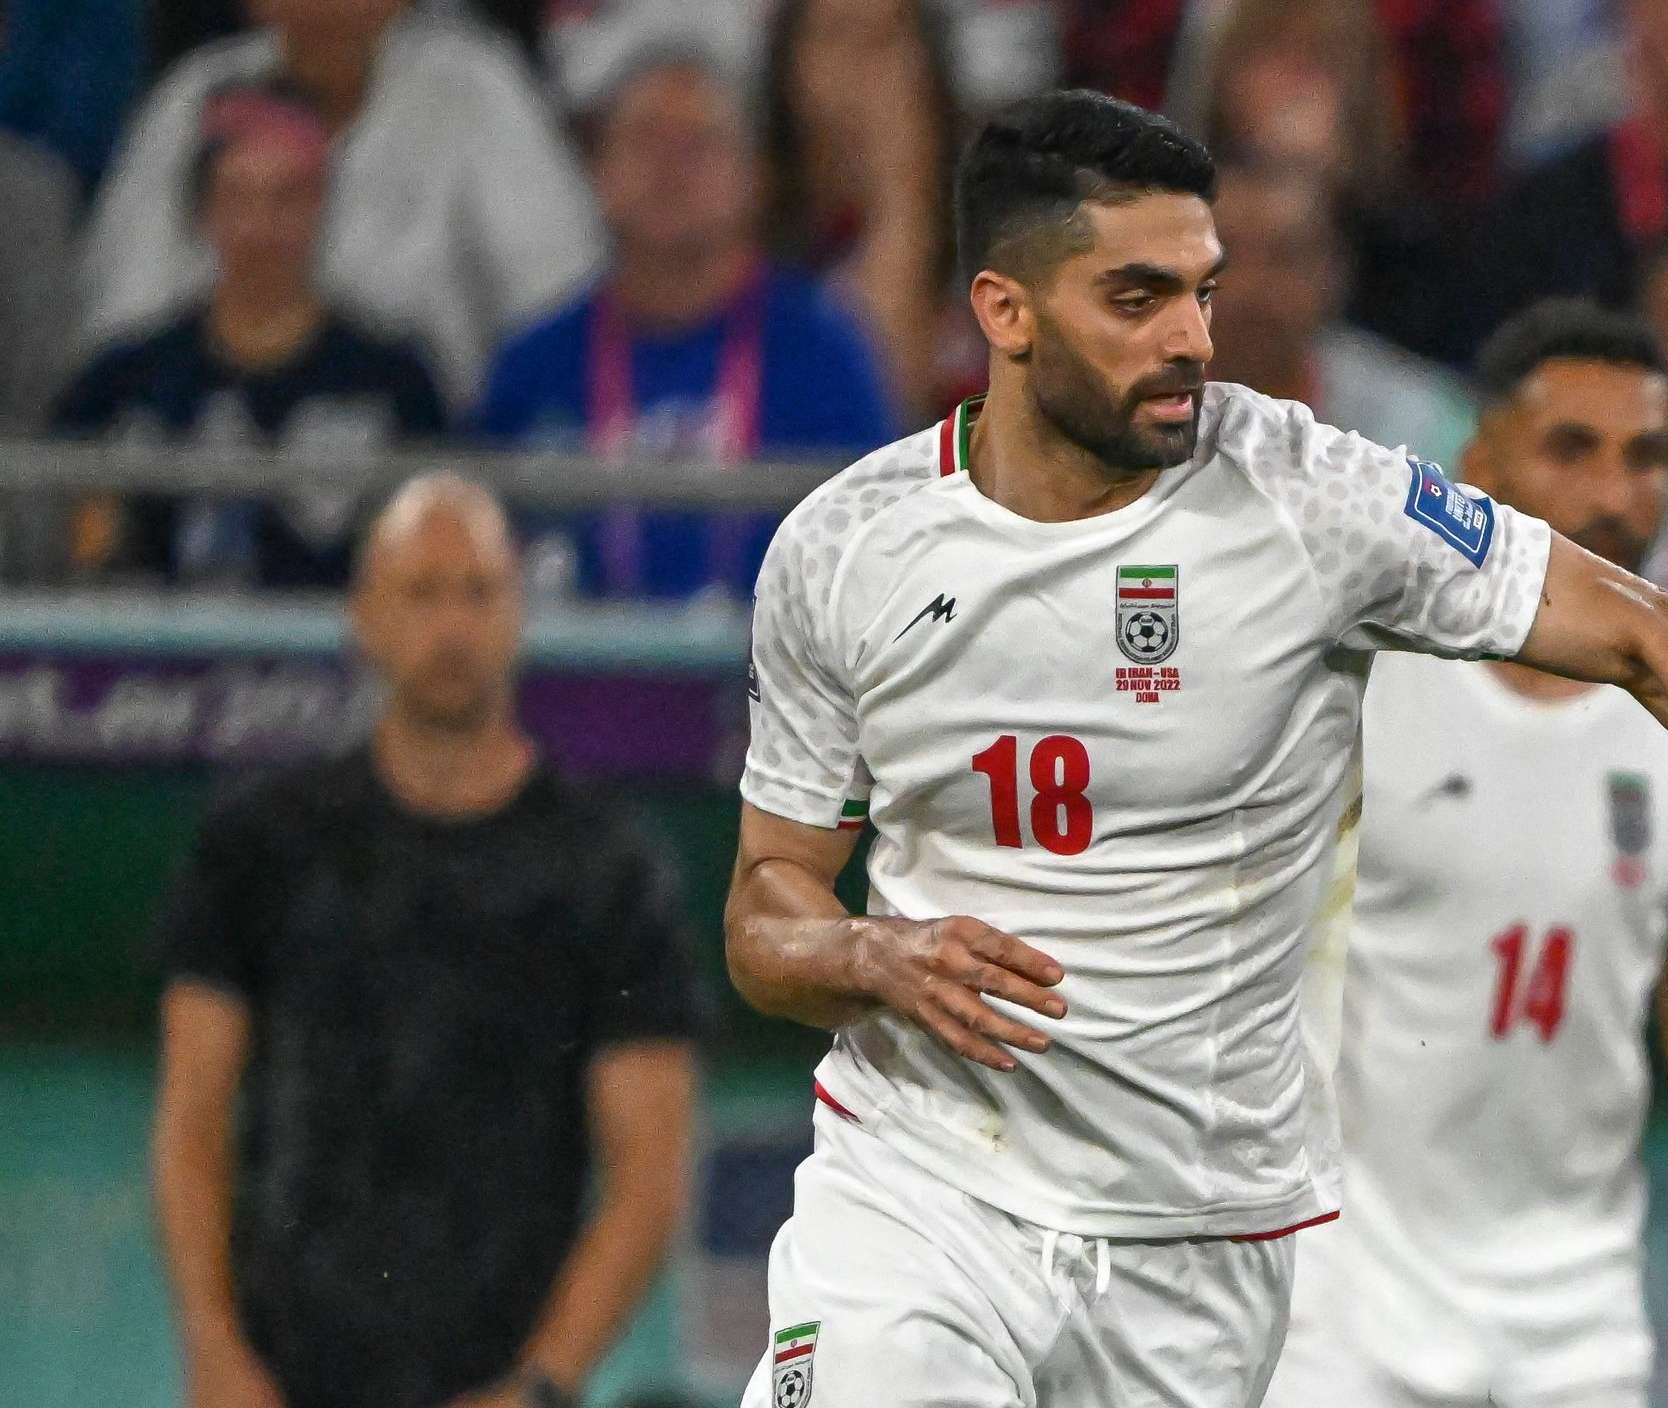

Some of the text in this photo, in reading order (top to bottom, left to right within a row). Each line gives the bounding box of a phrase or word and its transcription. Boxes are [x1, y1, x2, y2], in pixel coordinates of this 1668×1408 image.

[1115, 679, 1181, 691] 29 NOV 2022
[972, 734, 1094, 856] 18
[1488, 921, 1576, 1043] 14
